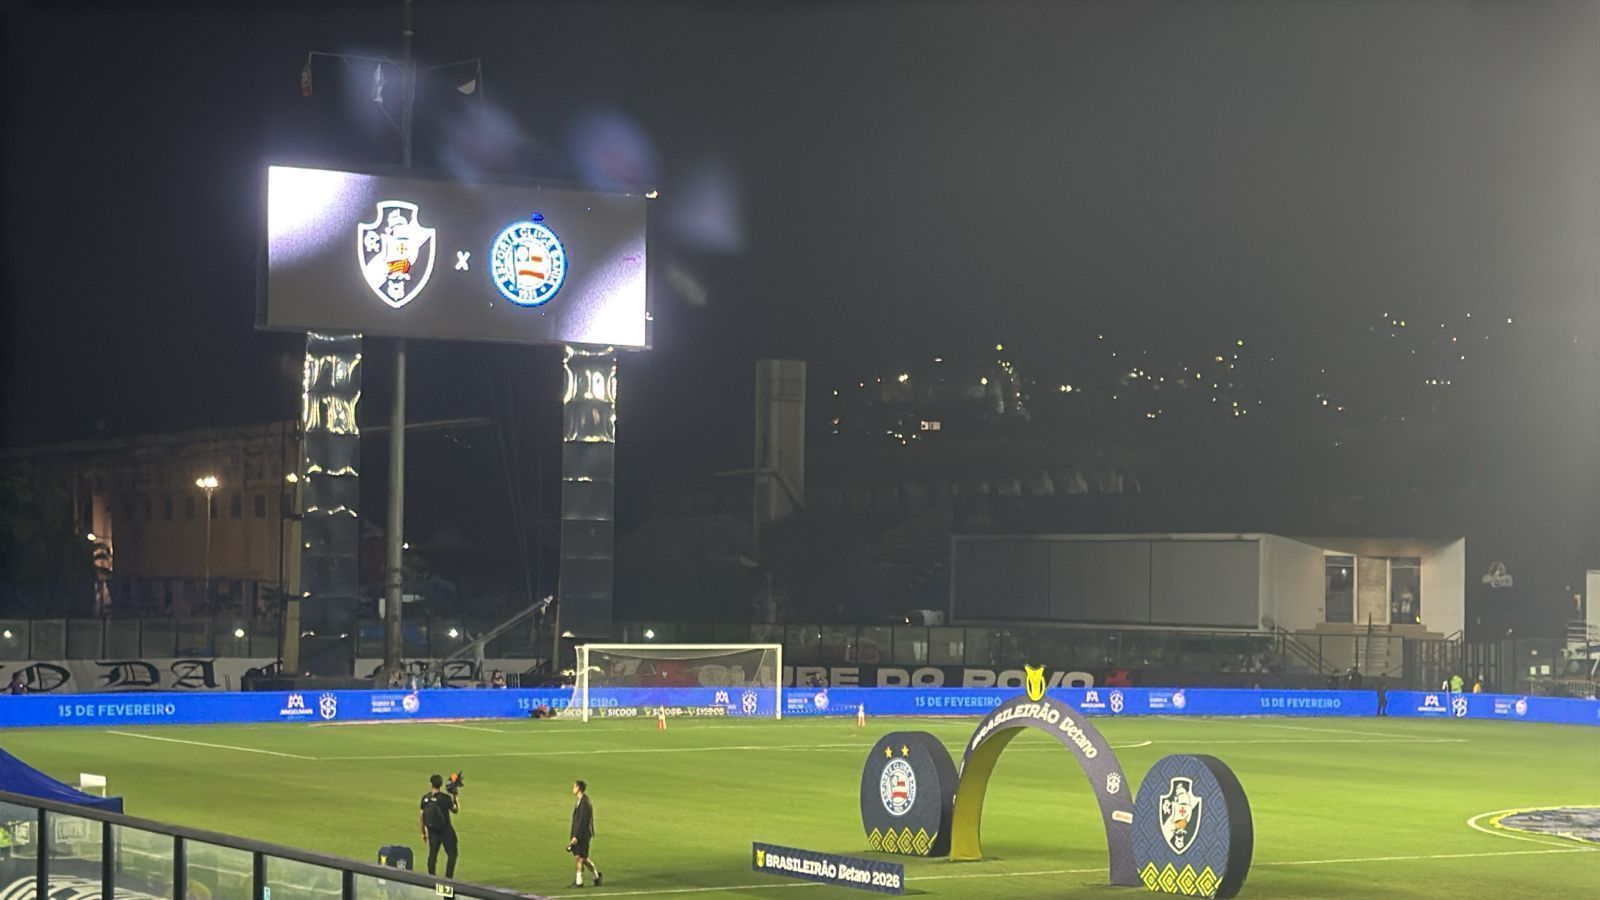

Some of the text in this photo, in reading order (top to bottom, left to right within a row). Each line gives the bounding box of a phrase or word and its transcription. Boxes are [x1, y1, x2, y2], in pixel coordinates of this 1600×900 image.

[877, 667, 944, 688] DO
[518, 698, 618, 709] 15 DE FEVEEIRO
[915, 697, 1002, 707] 15 DE FEVEREIRO
[1261, 698, 1341, 709] 15 DE FEVEREIRO
[58, 704, 175, 717] 15 DE FEVEREIRO
[607, 708, 637, 716] SICOOB
[1059, 717, 1097, 759] Betano
[766, 853, 900, 888] BRASILEIRÃO Betano 2026
